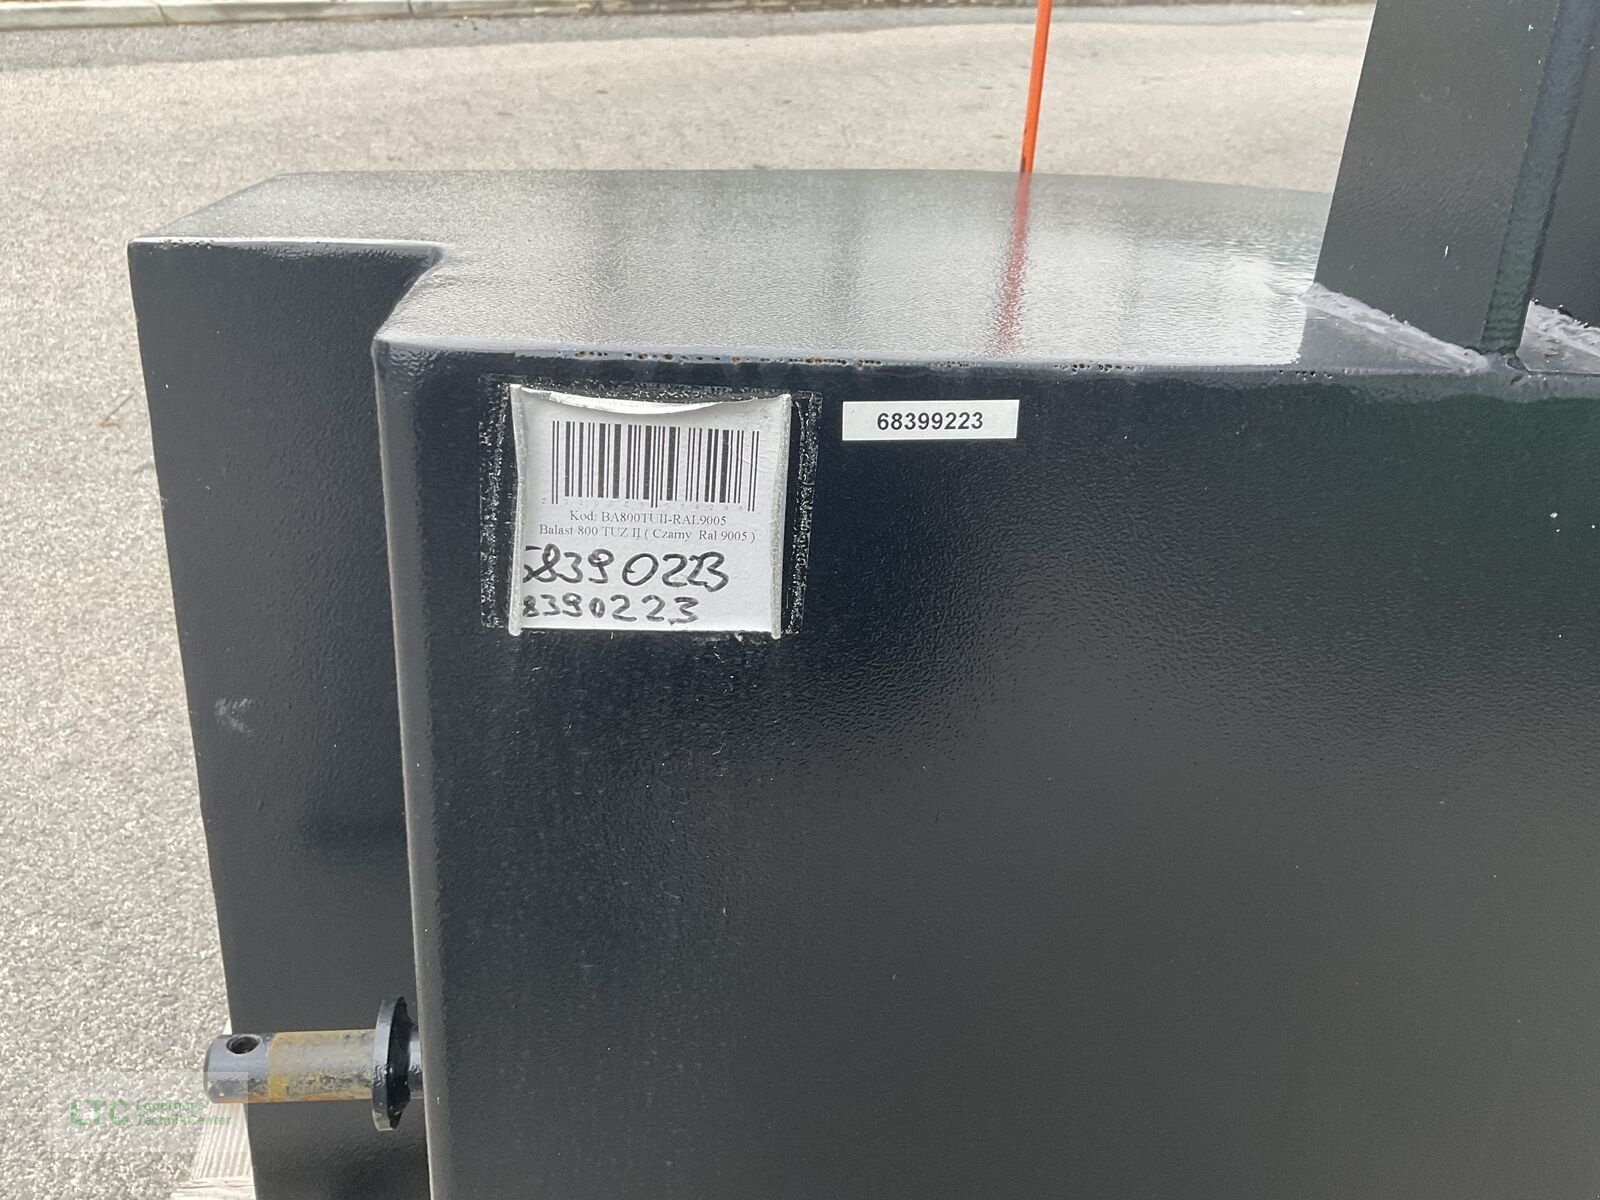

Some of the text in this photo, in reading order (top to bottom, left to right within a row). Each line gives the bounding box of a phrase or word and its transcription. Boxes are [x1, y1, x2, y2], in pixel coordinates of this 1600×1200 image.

[877, 412, 984, 430] 68399223
[570, 510, 597, 523] Kod:
[539, 524, 573, 536] Balast
[577, 526, 599, 537] 800
[602, 527, 629, 538] TUZ
[652, 529, 692, 543] Czarny
[698, 530, 718, 541] Ral
[720, 530, 748, 542] 9005
